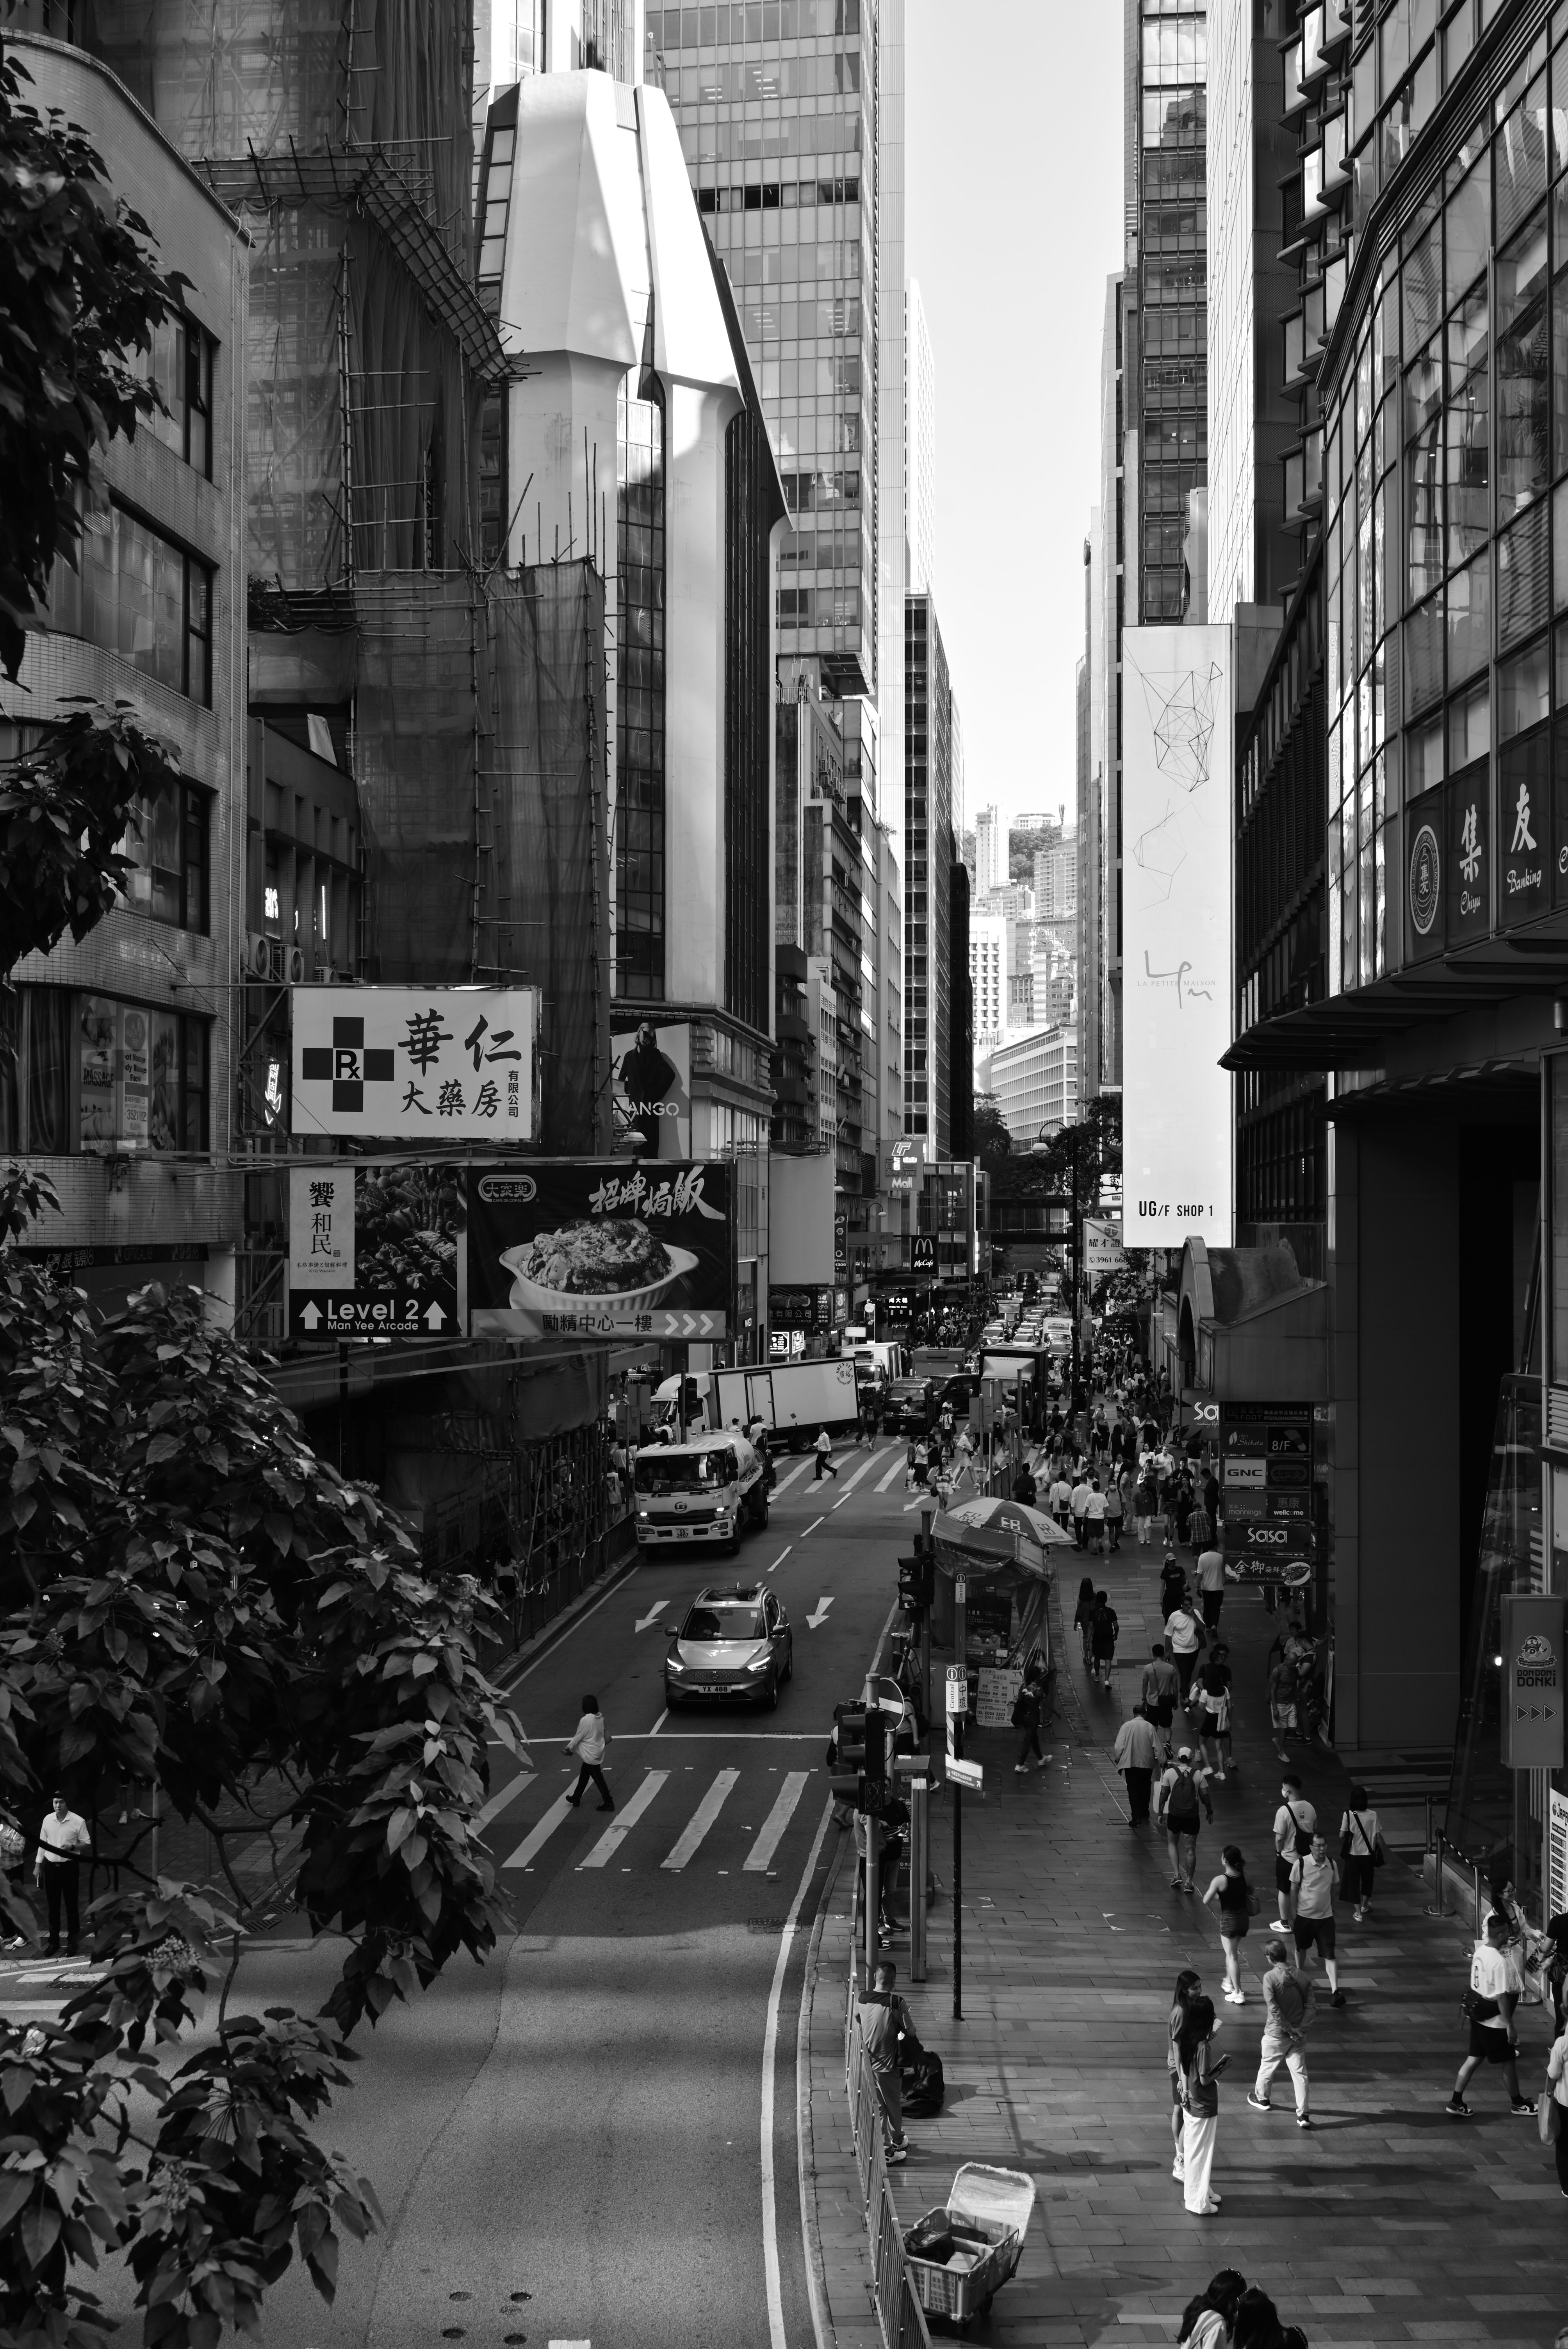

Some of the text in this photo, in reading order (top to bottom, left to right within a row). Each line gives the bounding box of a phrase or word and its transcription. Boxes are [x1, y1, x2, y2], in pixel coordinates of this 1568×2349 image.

[1461, 891, 1480, 915] Chiyu
[1507, 870, 1541, 894] Banking
[397, 1008, 522, 1077] 華仁
[83, 1068, 114, 1089] MASSAGE
[400, 1079, 502, 1117] 大藥房
[508, 1070, 519, 1117] 有限公司
[891, 1177, 912, 1188] Mall
[588, 1165, 726, 1221] 招牌焗飯
[309, 1182, 334, 1255] 饗和民
[1139, 1201, 1213, 1217] UG/F SHOP 1
[328, 1299, 419, 1320] Level 2
[328, 1321, 419, 1330] Man Yee Arcade
[542, 1314, 652, 1332] 勵精中心一樓
[1272, 1440, 1291, 1451] 8/F
[1278, 1497, 1300, 1508] 惠康
[1247, 1527, 1287, 1543] Sasa
[1235, 1560, 1265, 1574] 金御
[1517, 1677, 1556, 1687] DONKI
[959, 1684, 966, 1709] 中環
